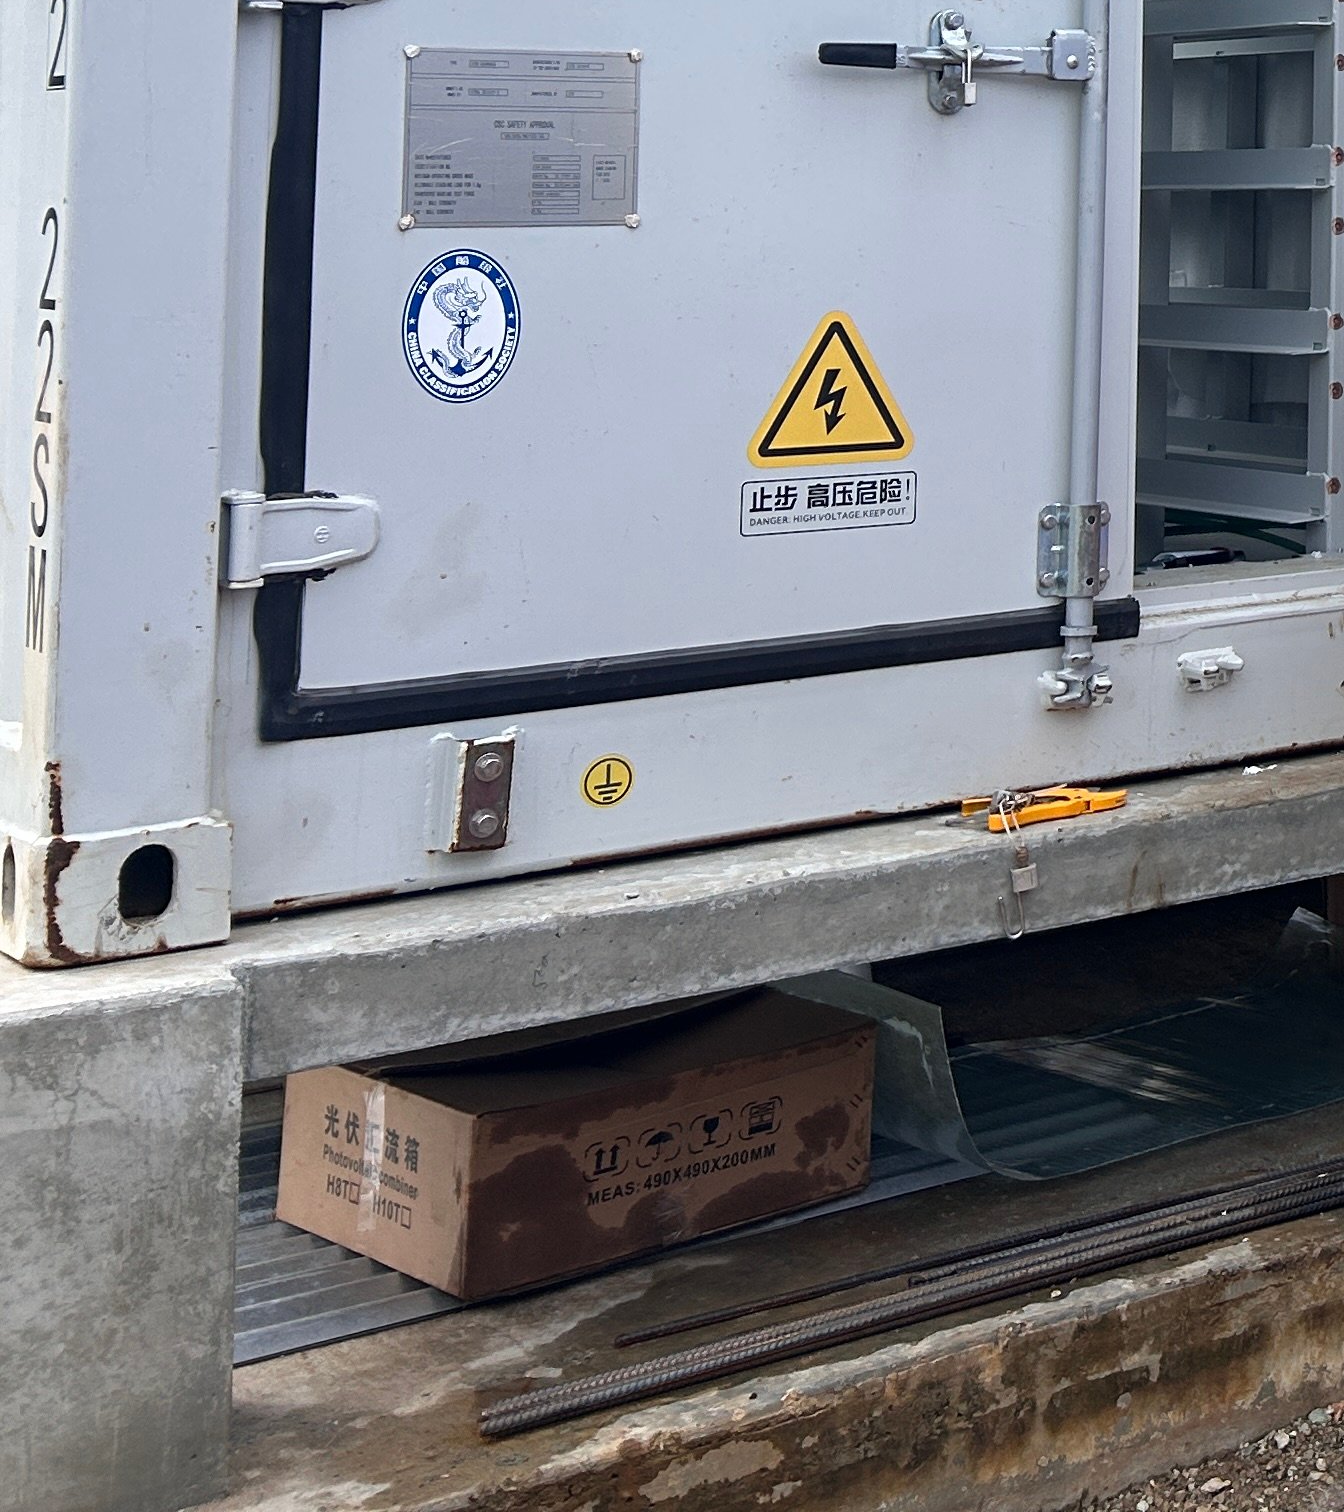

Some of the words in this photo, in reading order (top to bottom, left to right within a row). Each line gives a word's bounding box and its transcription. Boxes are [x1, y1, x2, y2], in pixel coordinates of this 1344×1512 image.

[407, 331, 424, 368] CHINA
[419, 364, 498, 397] CLASSIFICATION
[494, 326, 516, 372] SOCIETY
[749, 485, 798, 513] 止步
[793, 513, 817, 523] HIGH
[379, 1170, 419, 1201] combiner
